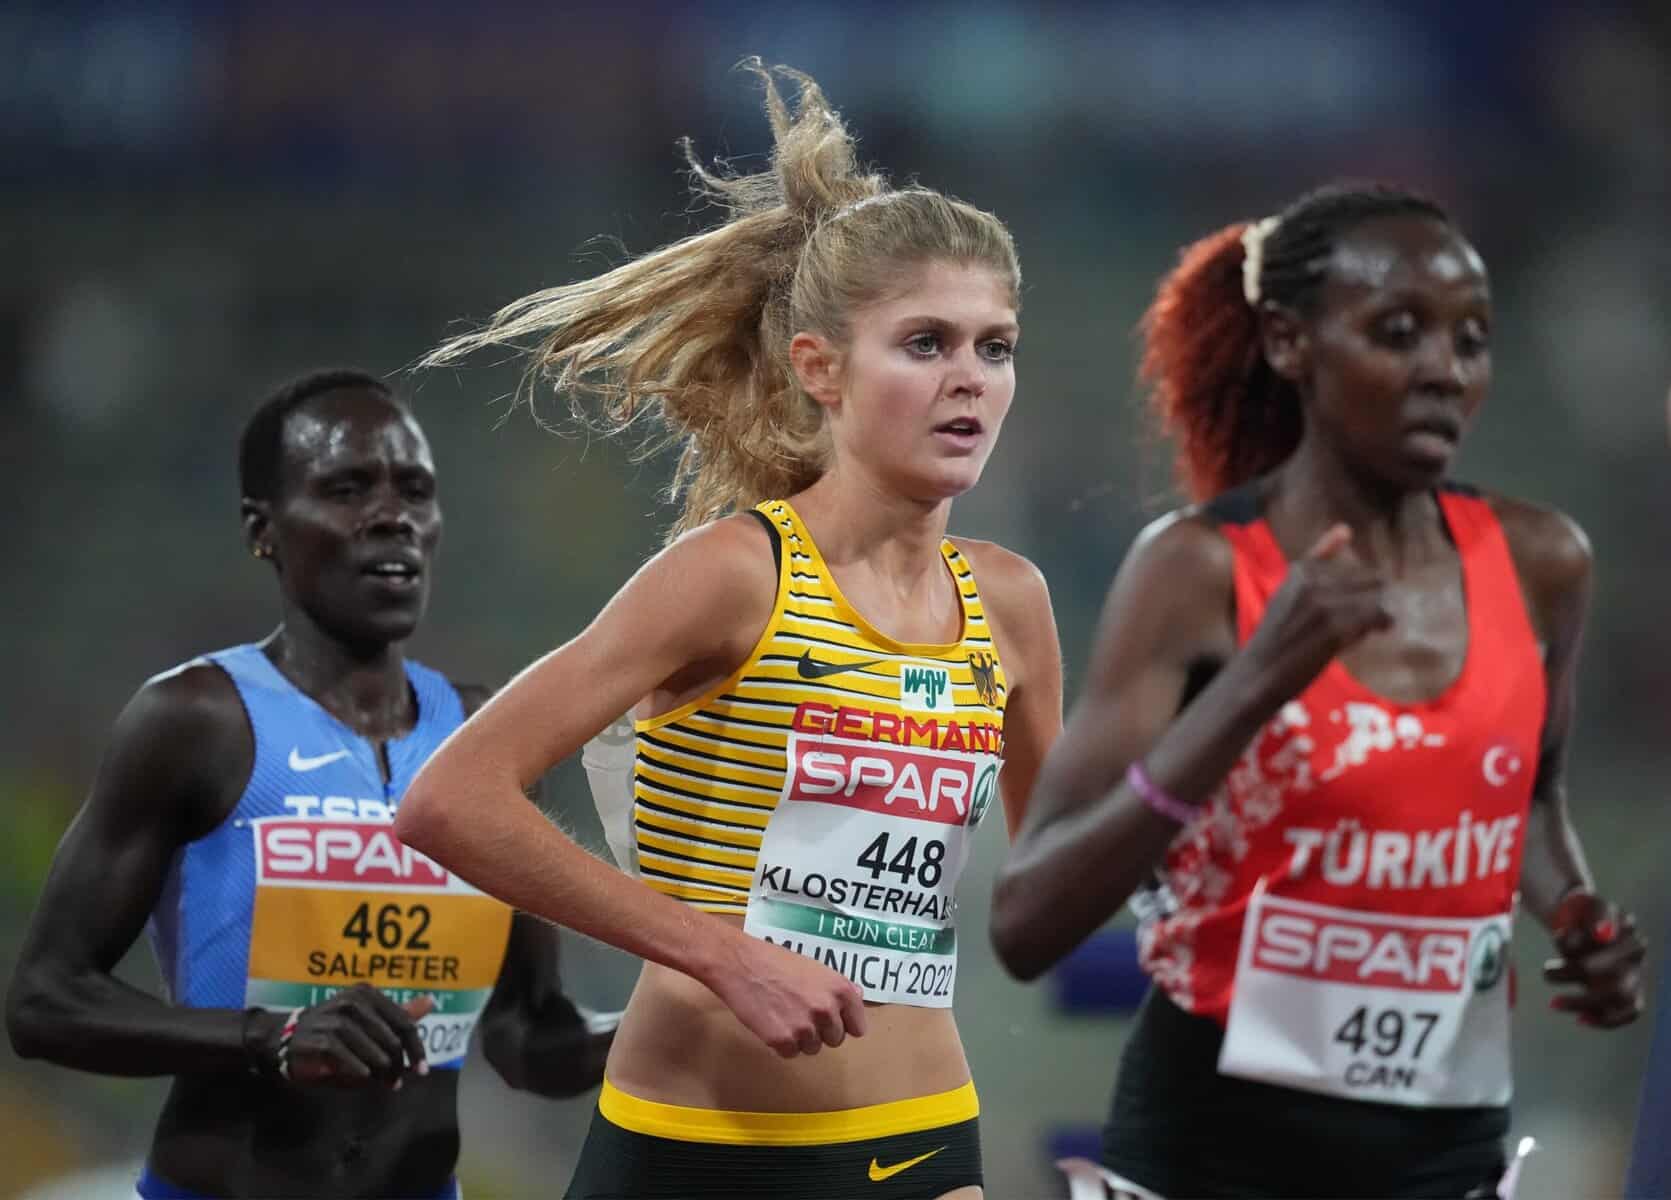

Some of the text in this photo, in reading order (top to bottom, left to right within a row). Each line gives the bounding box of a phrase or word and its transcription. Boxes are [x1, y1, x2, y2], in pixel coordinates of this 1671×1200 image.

[791, 701, 1001, 756] GERMANY
[799, 750, 969, 816] SPAR
[857, 831, 946, 889] 448
[1284, 808, 1521, 890] TÜRKİYE
[343, 903, 431, 950] 462
[817, 913, 825, 933] I
[832, 916, 879, 943] RUN
[1260, 914, 1466, 986] SPAR
[307, 952, 460, 981] SALPETER
[764, 935, 953, 997] NICH 2022
[1335, 1004, 1440, 1059] 497
[1344, 1062, 1418, 1089] CAN
